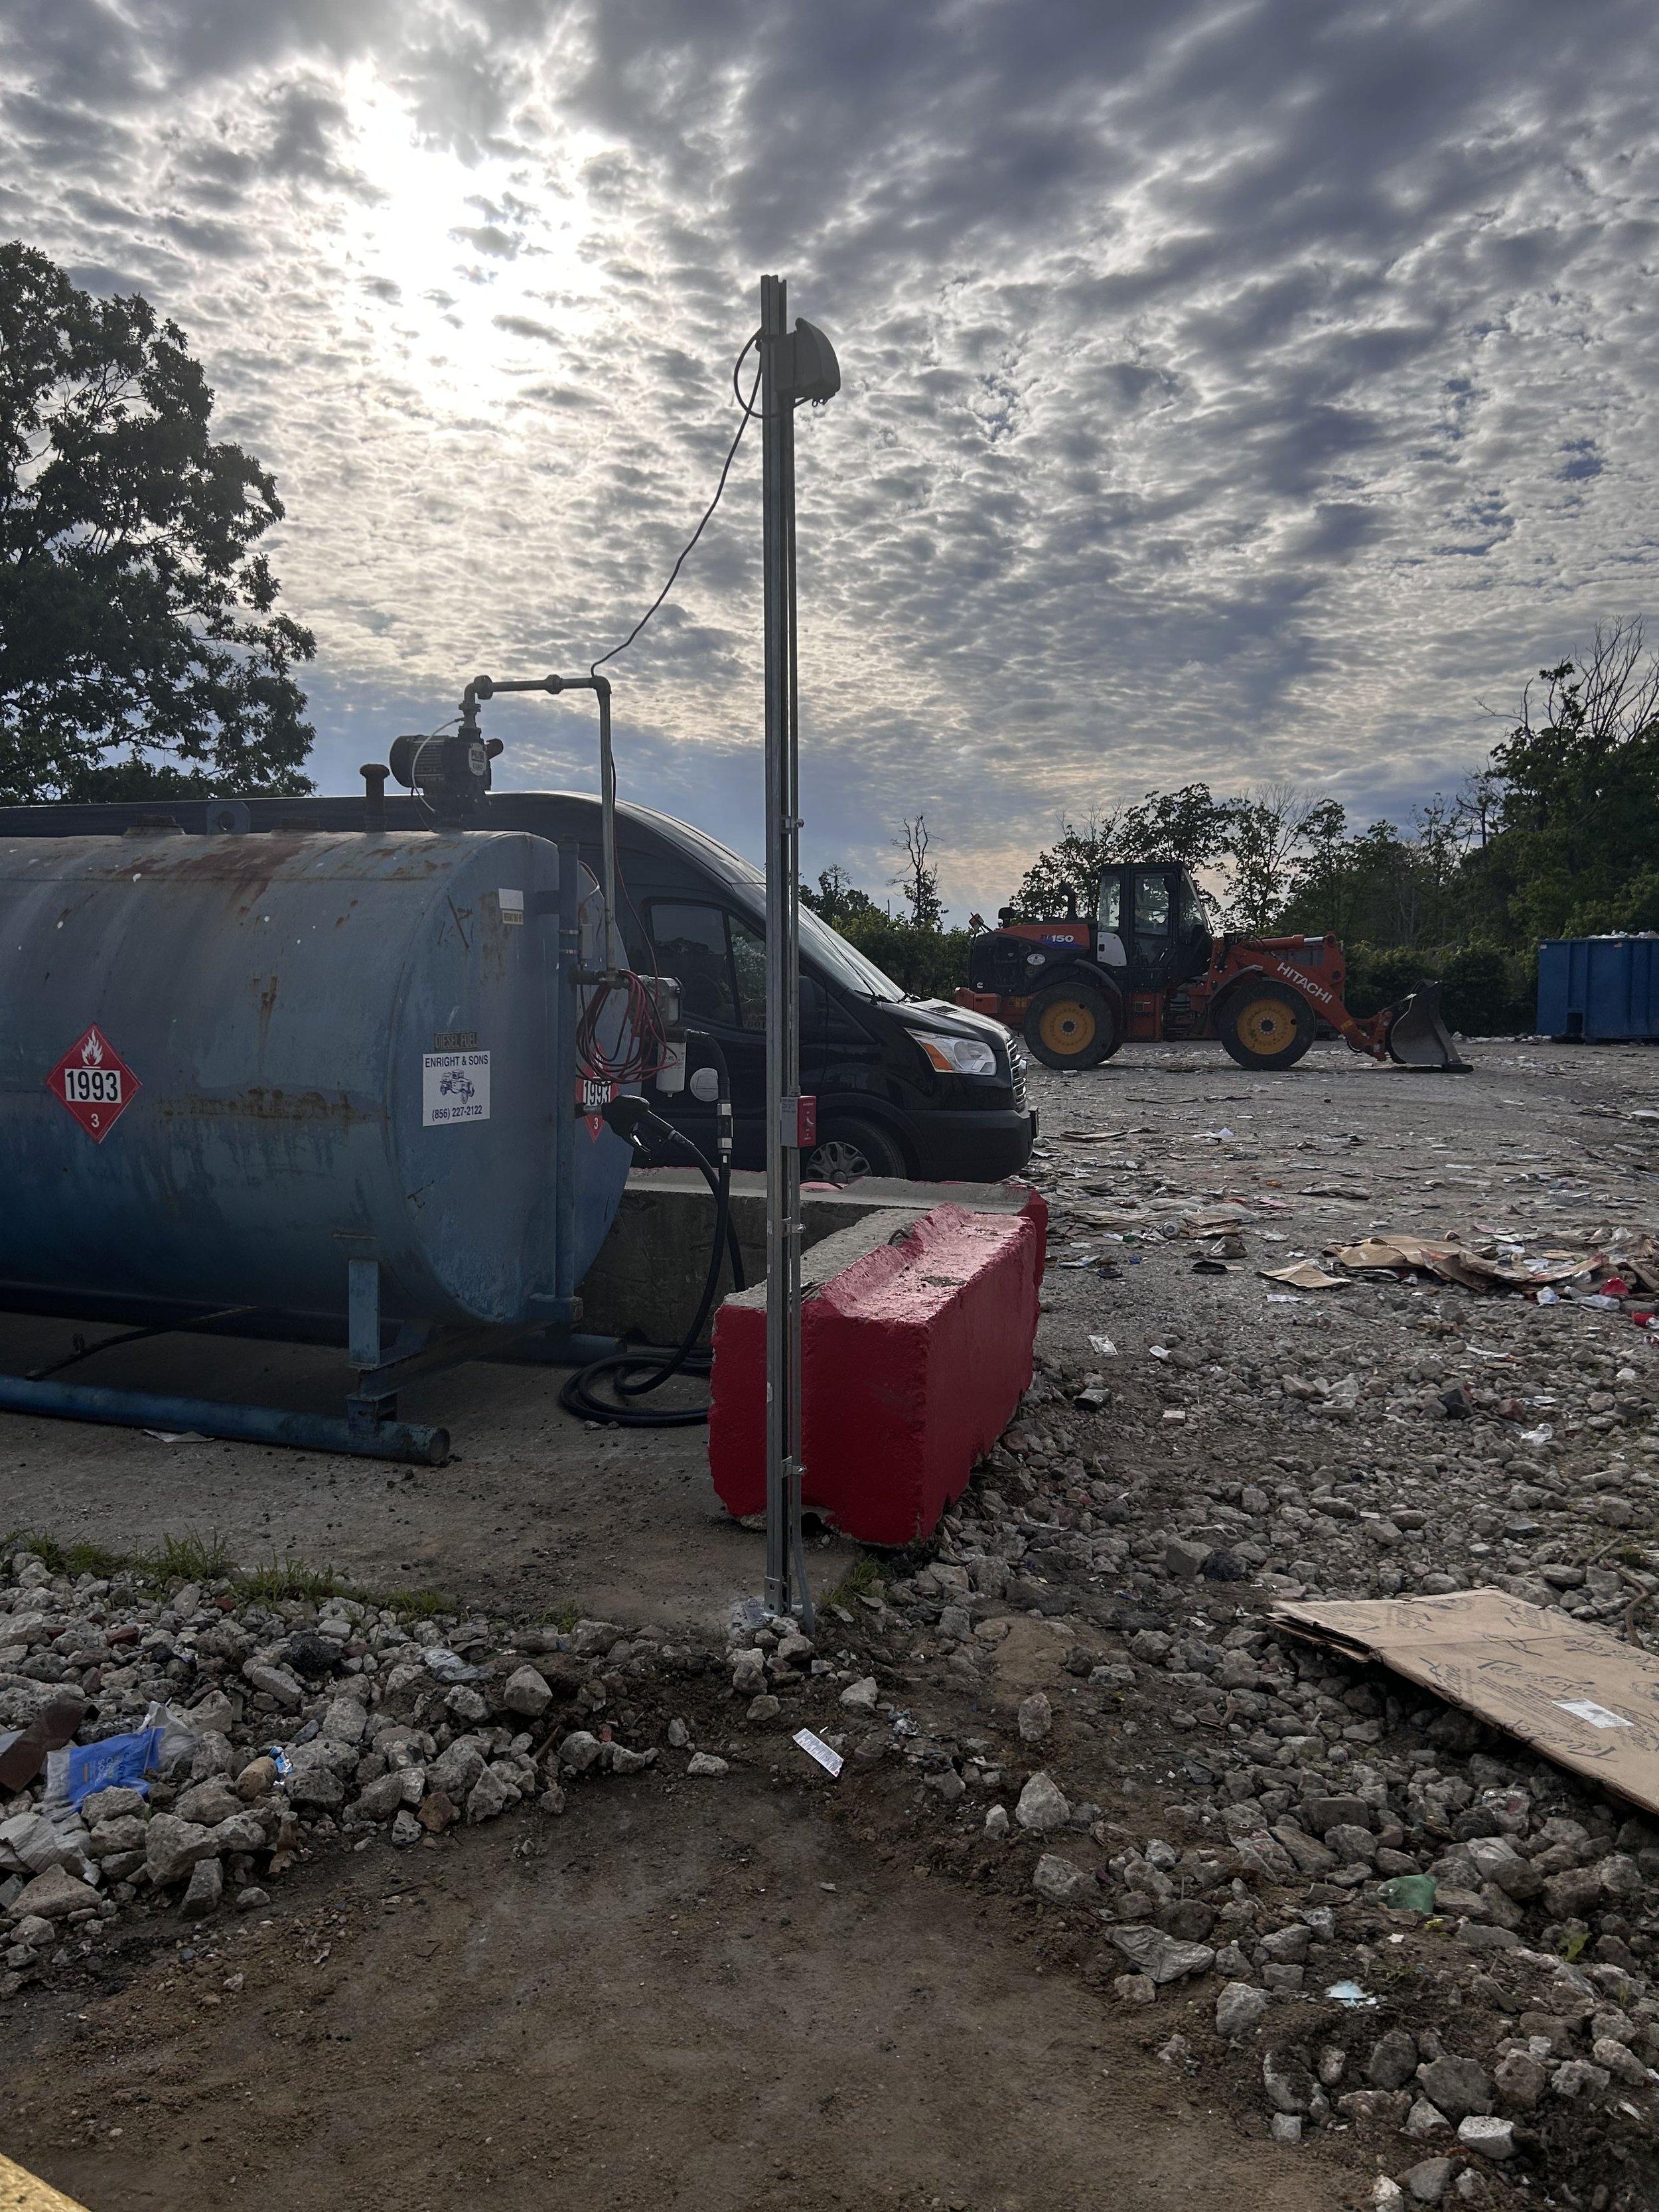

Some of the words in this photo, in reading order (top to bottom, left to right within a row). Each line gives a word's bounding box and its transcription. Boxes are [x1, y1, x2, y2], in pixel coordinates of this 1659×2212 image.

[1277, 962, 1333, 1003] HITACHI
[435, 1035, 459, 1049] DIESEL
[461, 1033, 478, 1048] FUEL
[425, 1056, 460, 1068] ENRIGHT
[462, 1056, 467, 1065] &
[469, 1055, 488, 1065] SONS
[66, 1070, 118, 1101] 1993
[585, 1081, 609, 1105] 1993
[91, 1113, 100, 1128] 3
[432, 1108, 450, 1122] (856)
[452, 1105, 482, 1117] 227-2122
[594, 1117, 599, 1130] 3
[1477, 1657, 1598, 1694] Telescope
